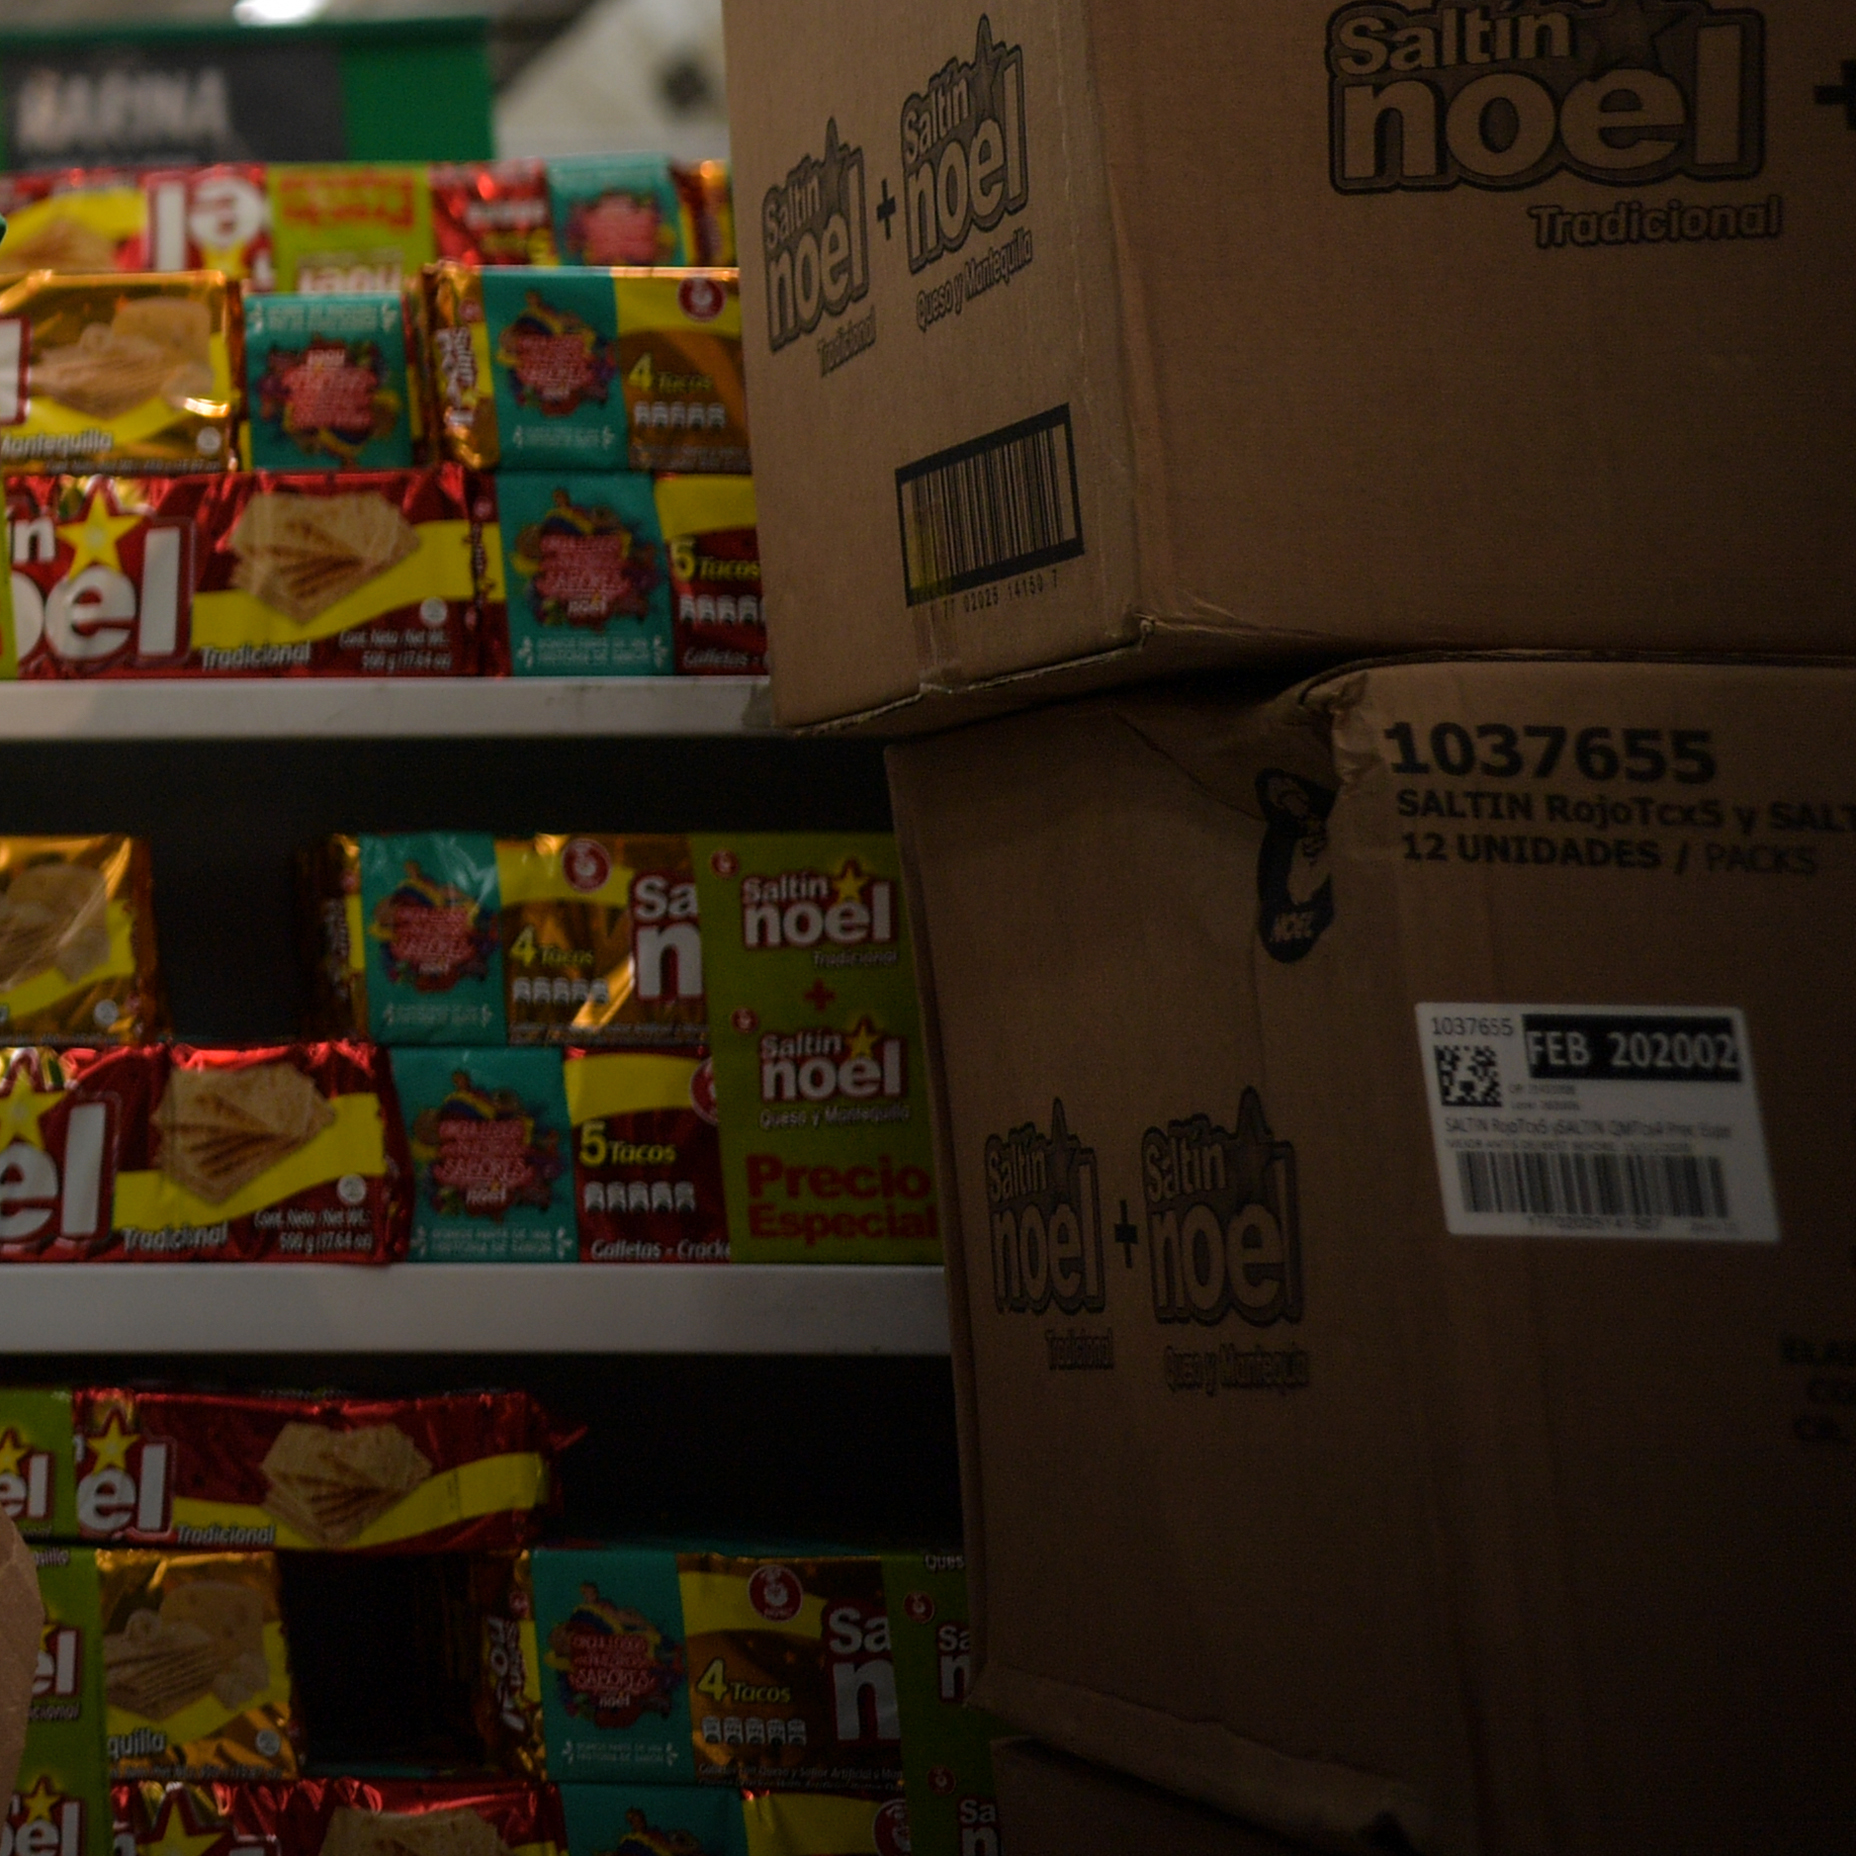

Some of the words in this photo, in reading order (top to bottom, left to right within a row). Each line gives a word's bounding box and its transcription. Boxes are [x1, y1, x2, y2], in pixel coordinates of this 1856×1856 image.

[1335, 0, 1575, 77] Saltín
[904, 54, 970, 162] Saltín
[1338, 24, 1743, 179] noel
[909, 59, 1025, 265] noel
[764, 156, 821, 251] Saltín
[1530, 196, 1783, 250] Tradicional
[769, 147, 865, 348] noel
[916, 279, 954, 335] Queso
[964, 225, 1032, 305] Mantequilla
[818, 306, 876, 377] Tradicional
[628, 353, 653, 389] 4
[671, 532, 697, 582] 5
[201, 640, 311, 670] Tradicional
[1384, 721, 1717, 784] 1037655
[1396, 789, 1534, 820] SALTIN
[1545, 793, 1725, 830] RojoTcx5
[1733, 806, 1756, 835] y
[1401, 831, 1448, 861] 12
[1456, 833, 1661, 869] UNIDADES
[1706, 844, 1818, 876] PACKS
[741, 876, 829, 904] Saltín
[744, 881, 891, 949] noel
[510, 926, 536, 967] 4
[812, 949, 900, 968] Tradicional
[760, 1029, 843, 1062] Saltín
[1430, 1016, 1515, 1037] 1037655
[1524, 1030, 1592, 1067] FEB
[1606, 1031, 1740, 1069] 202002
[762, 1041, 902, 1102] noel
[759, 1109, 806, 1130] Queso
[808, 1113, 823, 1130] y
[825, 1101, 911, 1126] Mantequilla
[579, 1120, 606, 1168] 5
[606, 1144, 677, 1167] Tacos
[745, 1154, 933, 1202] Precio
[121, 1223, 229, 1253] Tradicional
[749, 1204, 939, 1245] Especial
[993, 1160, 1098, 1309] noel
[590, 1239, 663, 1261] Galletas
[76, 1442, 167, 1533] el
[176, 1523, 275, 1546] Tradicional
[698, 1658, 727, 1702] 4
[731, 1681, 792, 1705] Tacos
[107, 1727, 166, 1761] quilla
